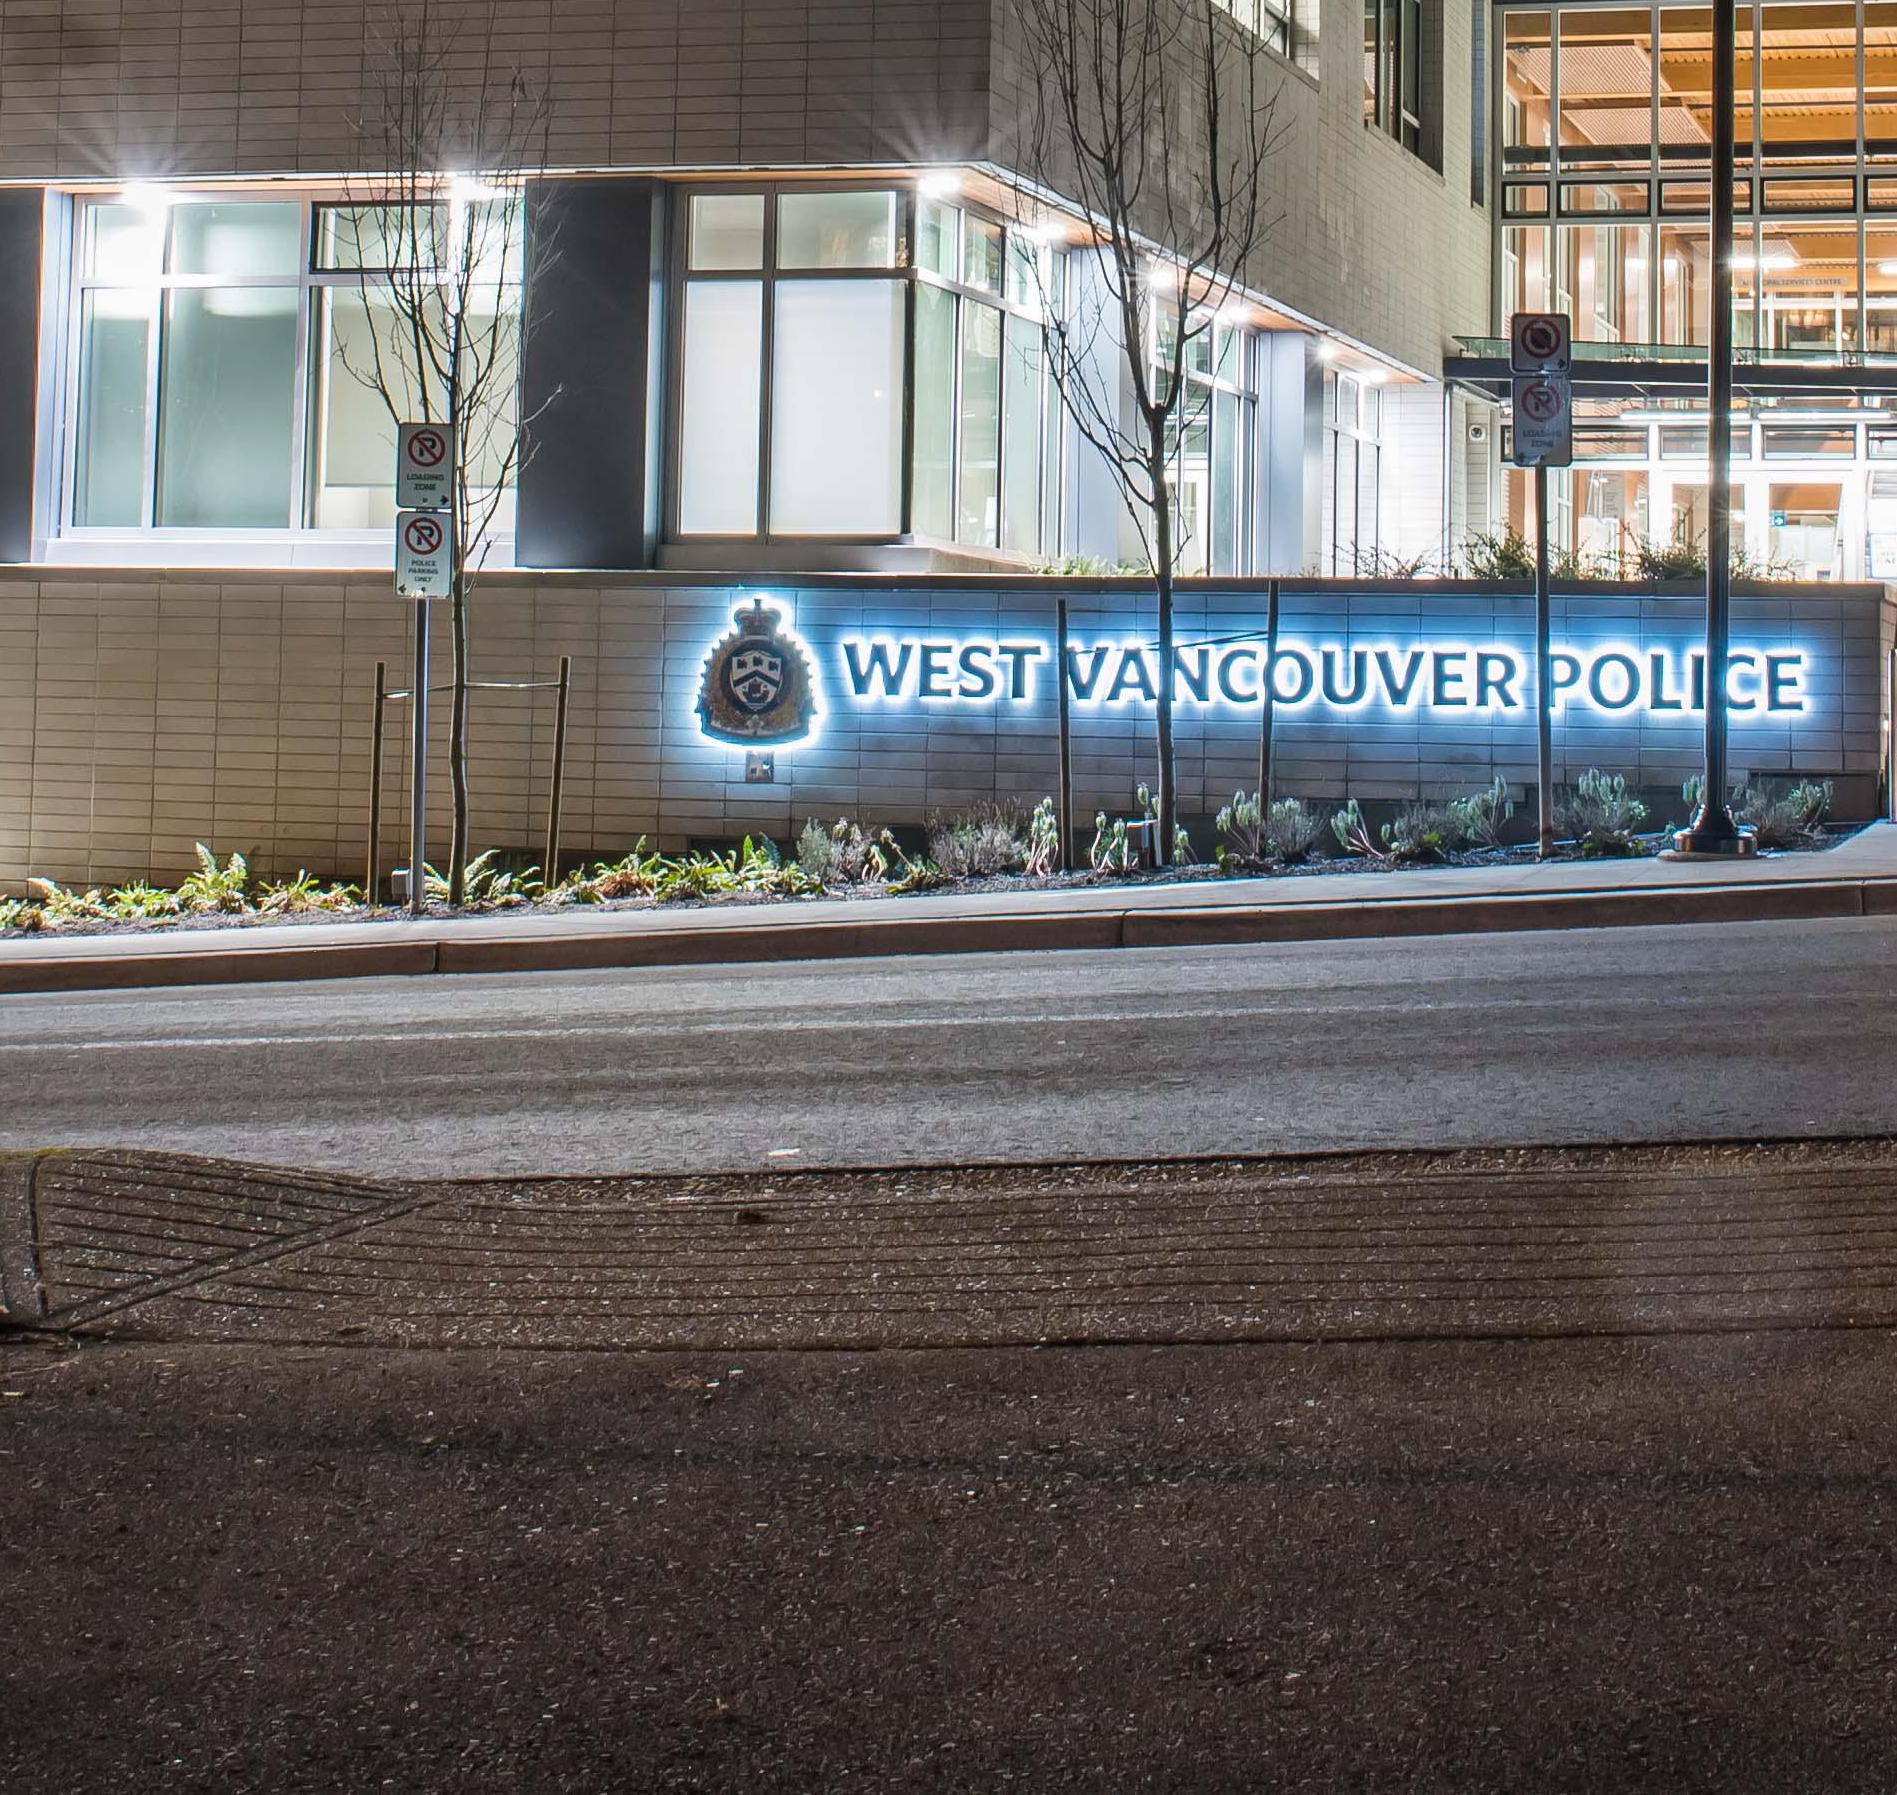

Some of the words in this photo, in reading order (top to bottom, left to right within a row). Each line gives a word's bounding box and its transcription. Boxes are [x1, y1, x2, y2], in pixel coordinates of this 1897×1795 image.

[406, 473, 445, 481] LOADING
[414, 483, 437, 491] ZONE
[842, 642, 1042, 699] WEST
[1066, 645, 1520, 707] VANCOUVER
[1546, 652, 1804, 711] POLICE
